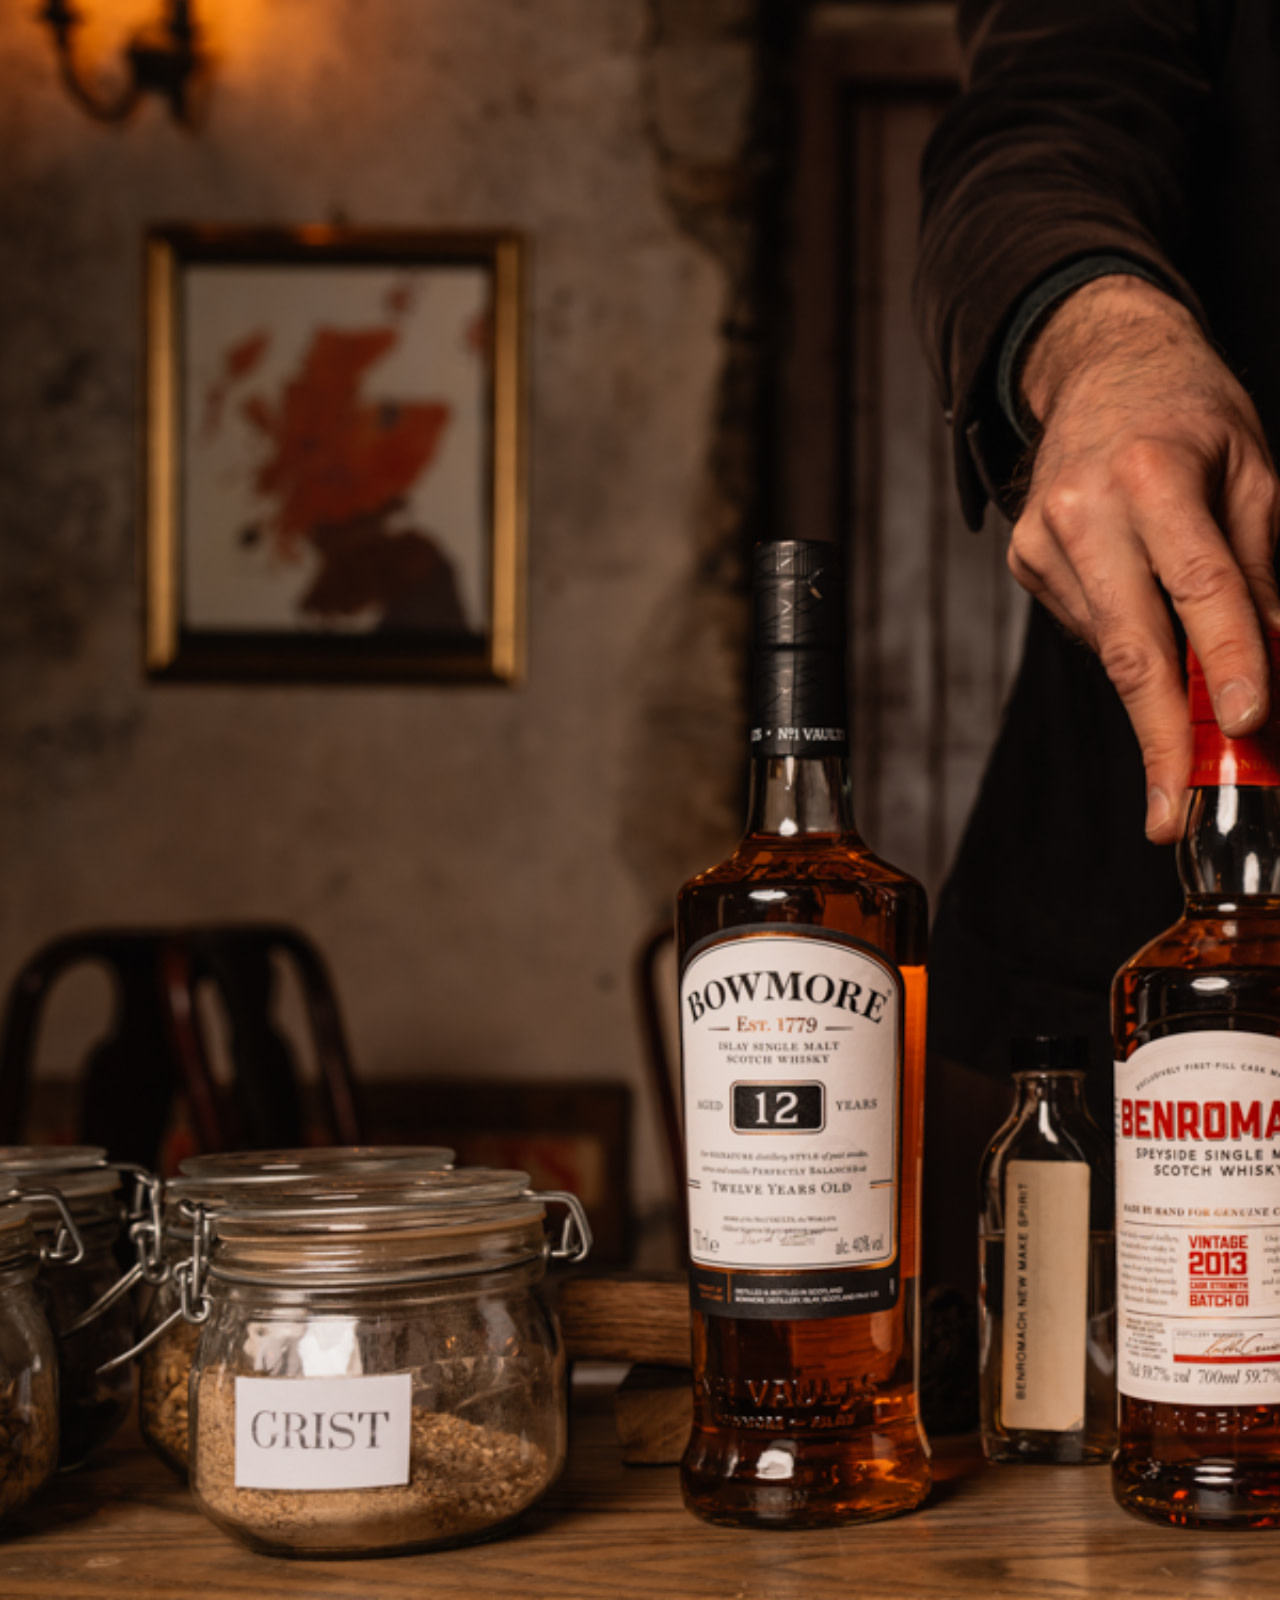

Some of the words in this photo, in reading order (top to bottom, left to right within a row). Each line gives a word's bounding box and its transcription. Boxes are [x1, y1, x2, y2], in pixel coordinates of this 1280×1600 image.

[686, 970, 888, 1024] BOWMORE
[778, 1017, 817, 1033] 1779
[718, 1041, 749, 1051] ISLAY
[753, 1042, 799, 1051] SINGLE
[803, 1041, 840, 1051] MALT
[726, 1055, 772, 1064] SCOTCH
[777, 1055, 830, 1064] WHISKY
[1135, 1065, 1181, 1091] EXCLUSIVELY
[1241, 1064, 1266, 1074] CASK
[697, 1100, 723, 1111] AGED
[755, 1091, 799, 1124] 12
[835, 1098, 878, 1111] YEARS
[1136, 1148, 1197, 1161] SPEYSIDE
[1205, 1148, 1264, 1161] SINGLE
[752, 1166, 806, 1176] PERFECTLY
[1154, 1165, 1212, 1177] SCOTCH
[711, 1181, 763, 1195] TWELVE
[767, 1182, 816, 1195] YEARS
[820, 1182, 852, 1194] OLD
[1018, 1183, 1028, 1227] SPIRIT
[1155, 1207, 1185, 1217] HAND
[1188, 1208, 1210, 1217] FOR
[1213, 1207, 1270, 1217] GENUINE
[1188, 1235, 1249, 1249] VINTAGE
[1017, 1233, 1028, 1272] MAKE
[1188, 1252, 1248, 1276] 2013
[1017, 1276, 1027, 1306] NEW
[1189, 1294, 1233, 1307] BATCH
[1235, 1294, 1249, 1307] 01
[1016, 1311, 1027, 1400] BENROMACH
[1198, 1369, 1240, 1384] 700ml
[251, 1409, 390, 1450] GRIST
